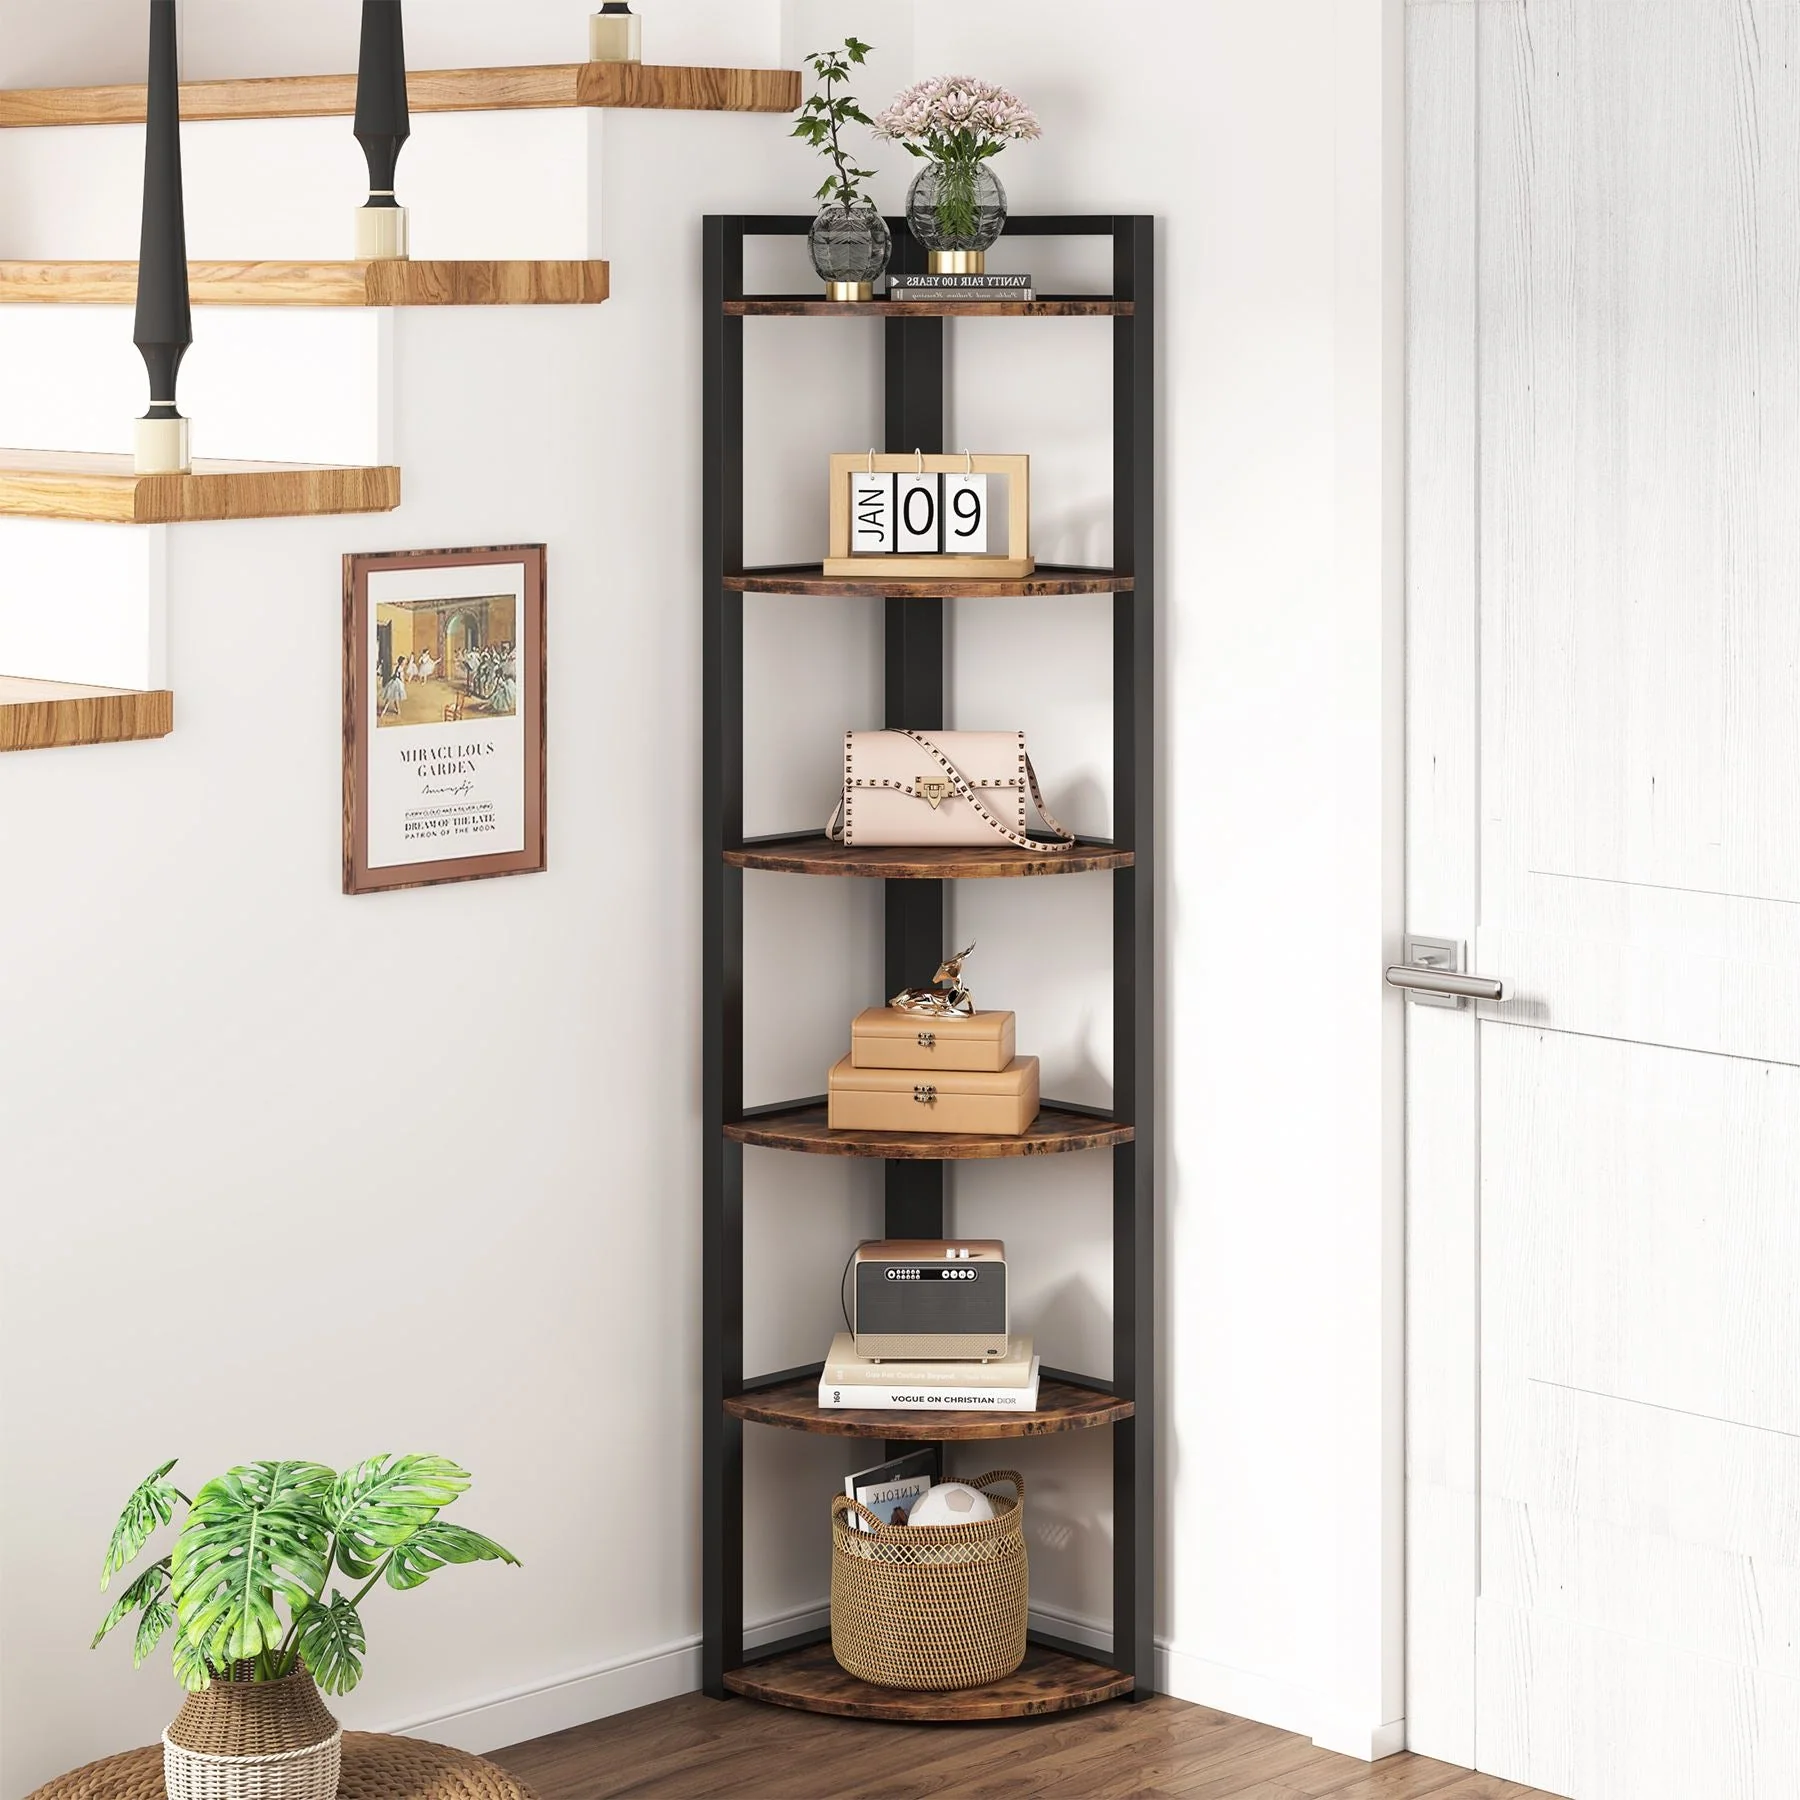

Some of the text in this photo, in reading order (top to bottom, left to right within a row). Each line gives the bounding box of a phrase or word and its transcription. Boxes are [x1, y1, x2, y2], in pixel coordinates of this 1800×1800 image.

[858, 489, 885, 542] JAN
[401, 742, 494, 762] MIRACULOUS
[417, 760, 476, 777] GARDEN
[405, 813, 495, 831] DREAM OF THE LATE
[405, 831, 437, 840] PATRON
[473, 824, 496, 832] MOON
[833, 1390, 841, 1403] 160
[891, 1395, 1017, 1405] VOGUE ON CHRISTIAN DIOR
